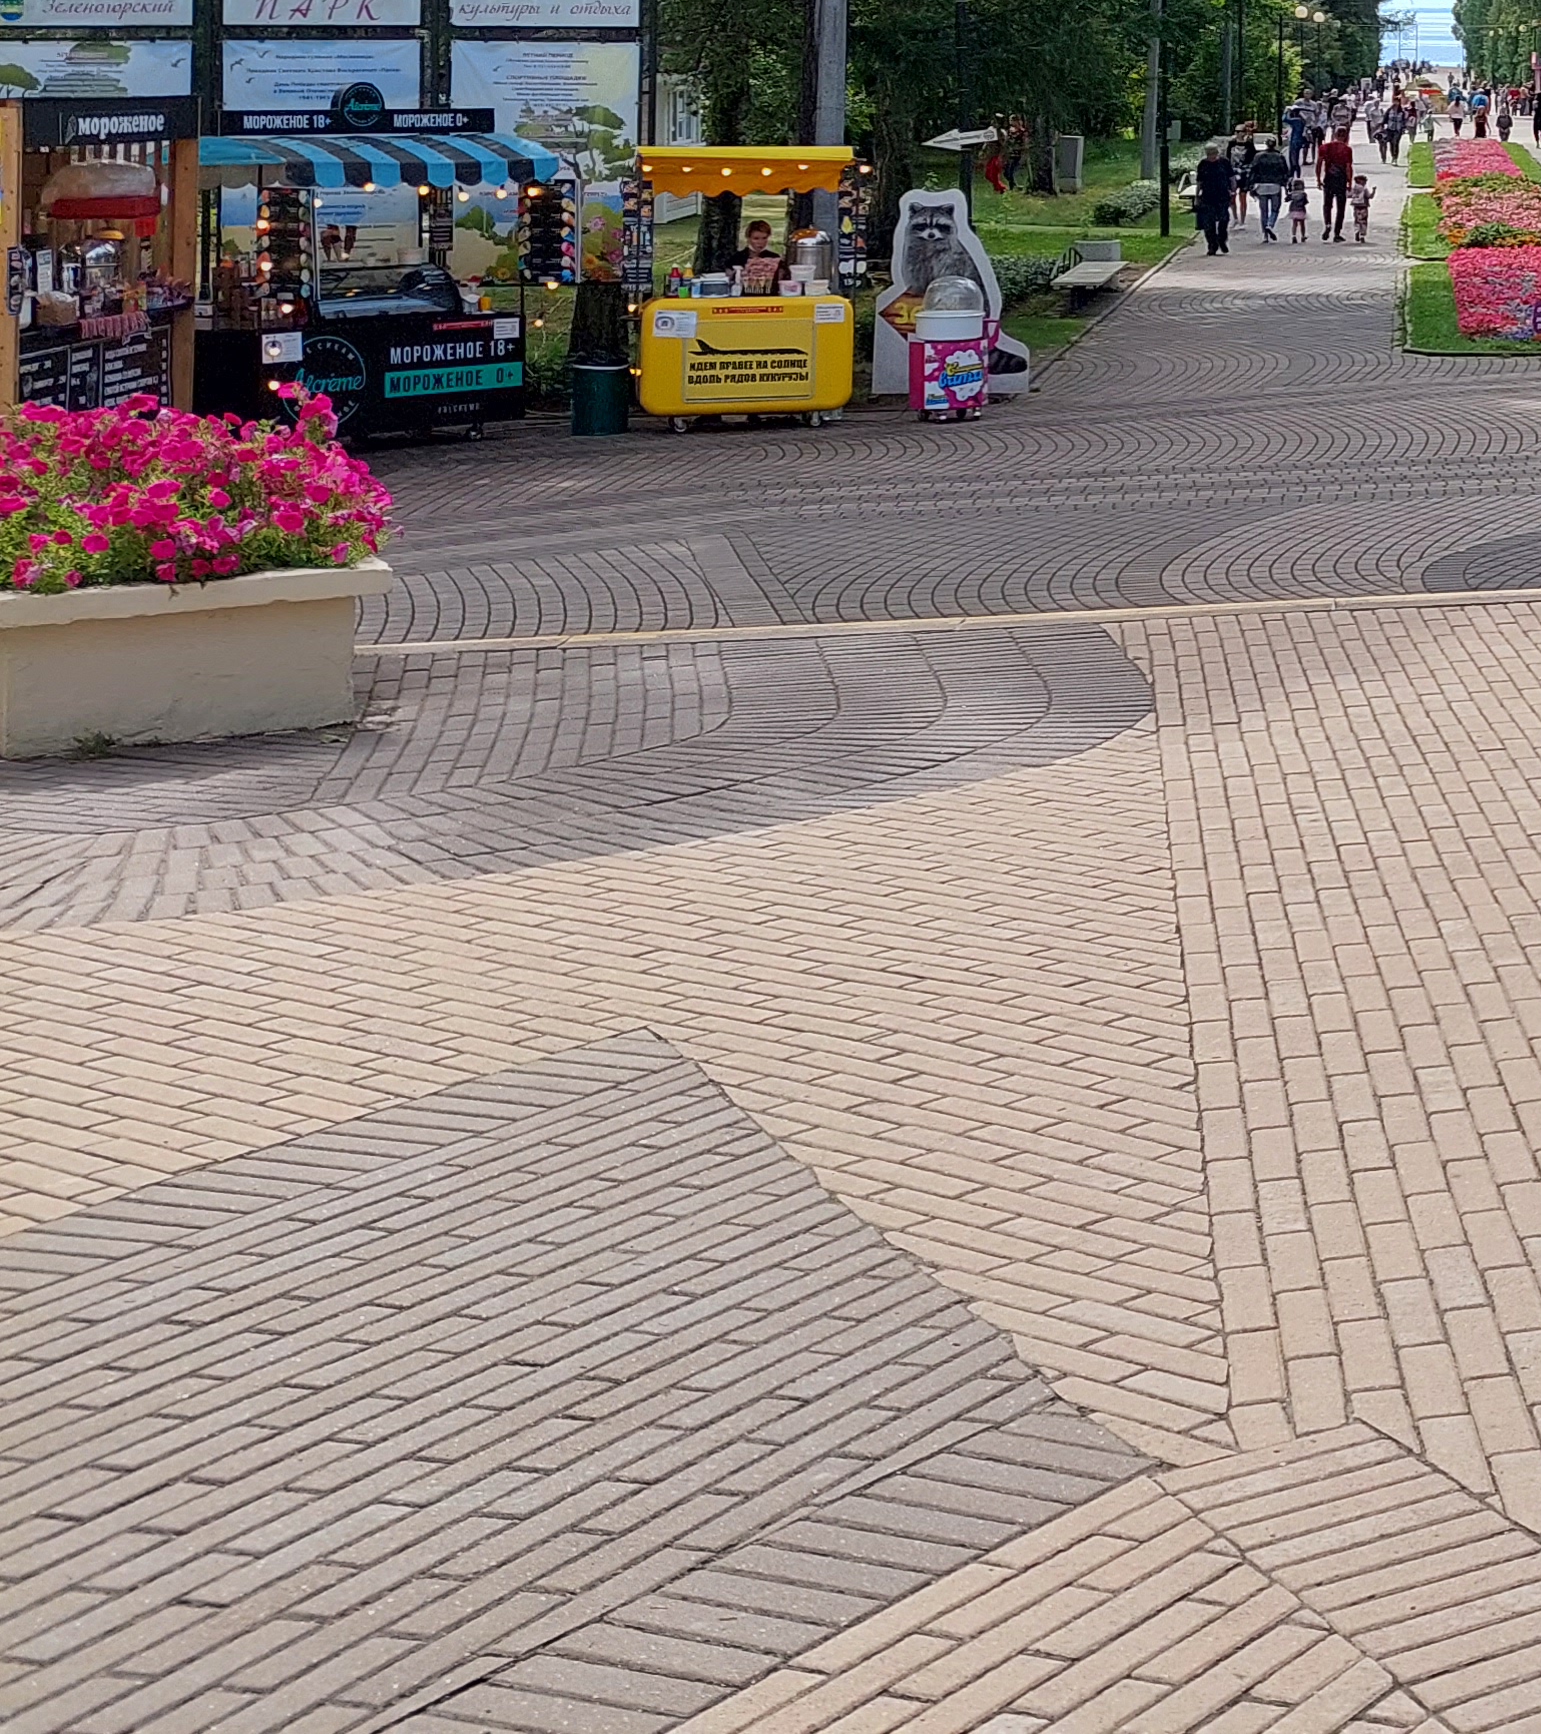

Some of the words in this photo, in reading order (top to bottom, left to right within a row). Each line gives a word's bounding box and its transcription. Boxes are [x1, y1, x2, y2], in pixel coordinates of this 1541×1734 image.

[458, 2, 541, 22] культуры
[550, 3, 561, 15] и
[569, 0, 632, 16] отдыха
[78, 114, 165, 140] мороженое
[243, 115, 310, 130] МОРОЖЕНОЕ
[312, 114, 332, 129] 18+
[393, 113, 455, 128] МОРОЖЕНОЕ
[456, 113, 469, 127] 0+
[390, 341, 484, 365] МОРОЖЕНОЕ
[489, 339, 516, 357] 18+
[389, 370, 484, 395] МОРОЖЕНОЕ
[496, 367, 514, 384] 0+
